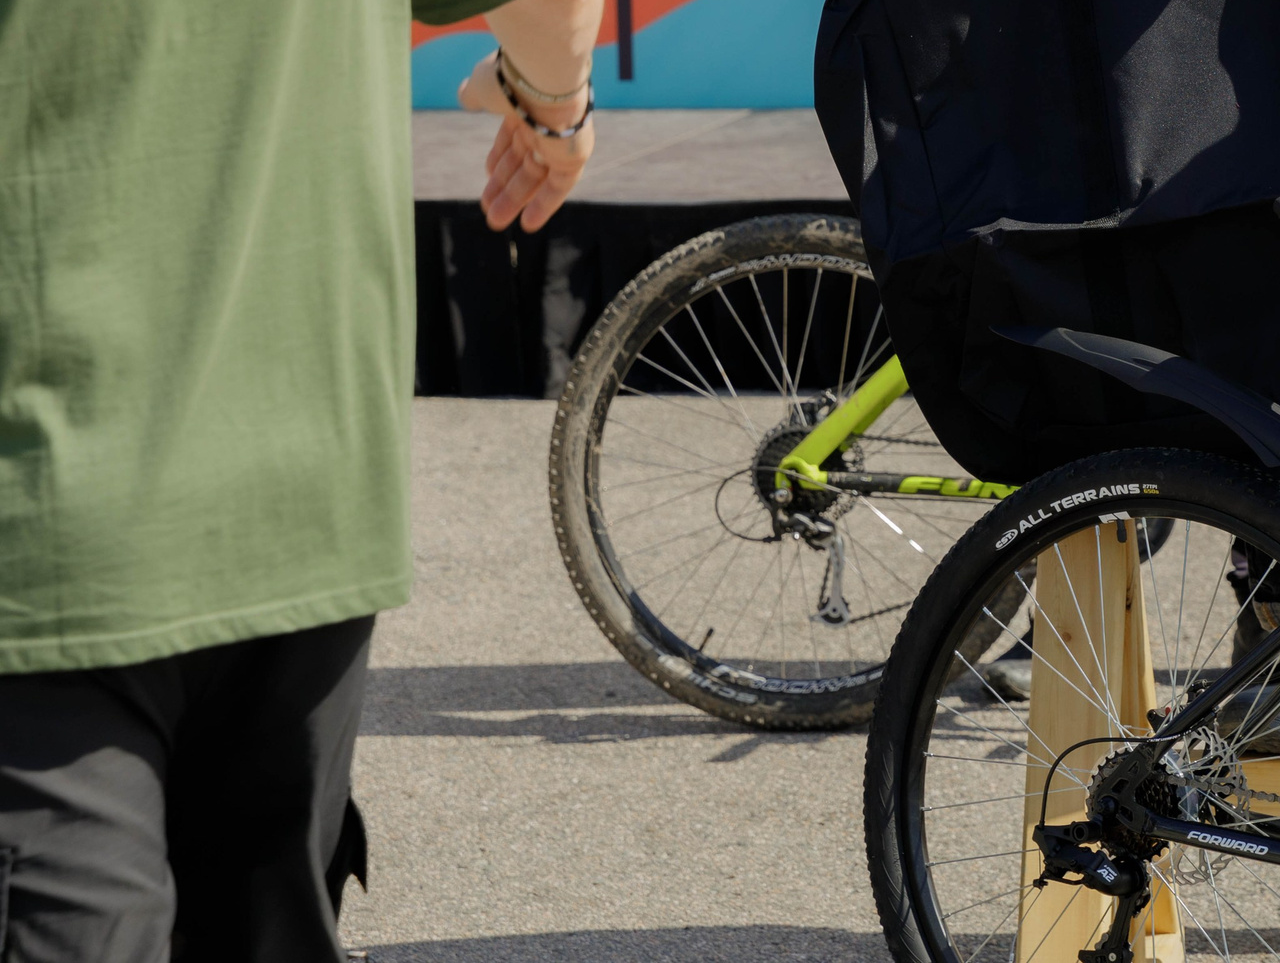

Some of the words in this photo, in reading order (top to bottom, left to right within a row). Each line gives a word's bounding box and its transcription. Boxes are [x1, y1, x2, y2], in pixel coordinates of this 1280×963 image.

[1018, 508, 1053, 534] ALL
[1050, 483, 1141, 513] TERRAINS
[1186, 829, 1270, 856] FORWARD
[1096, 866, 1115, 884] A2
